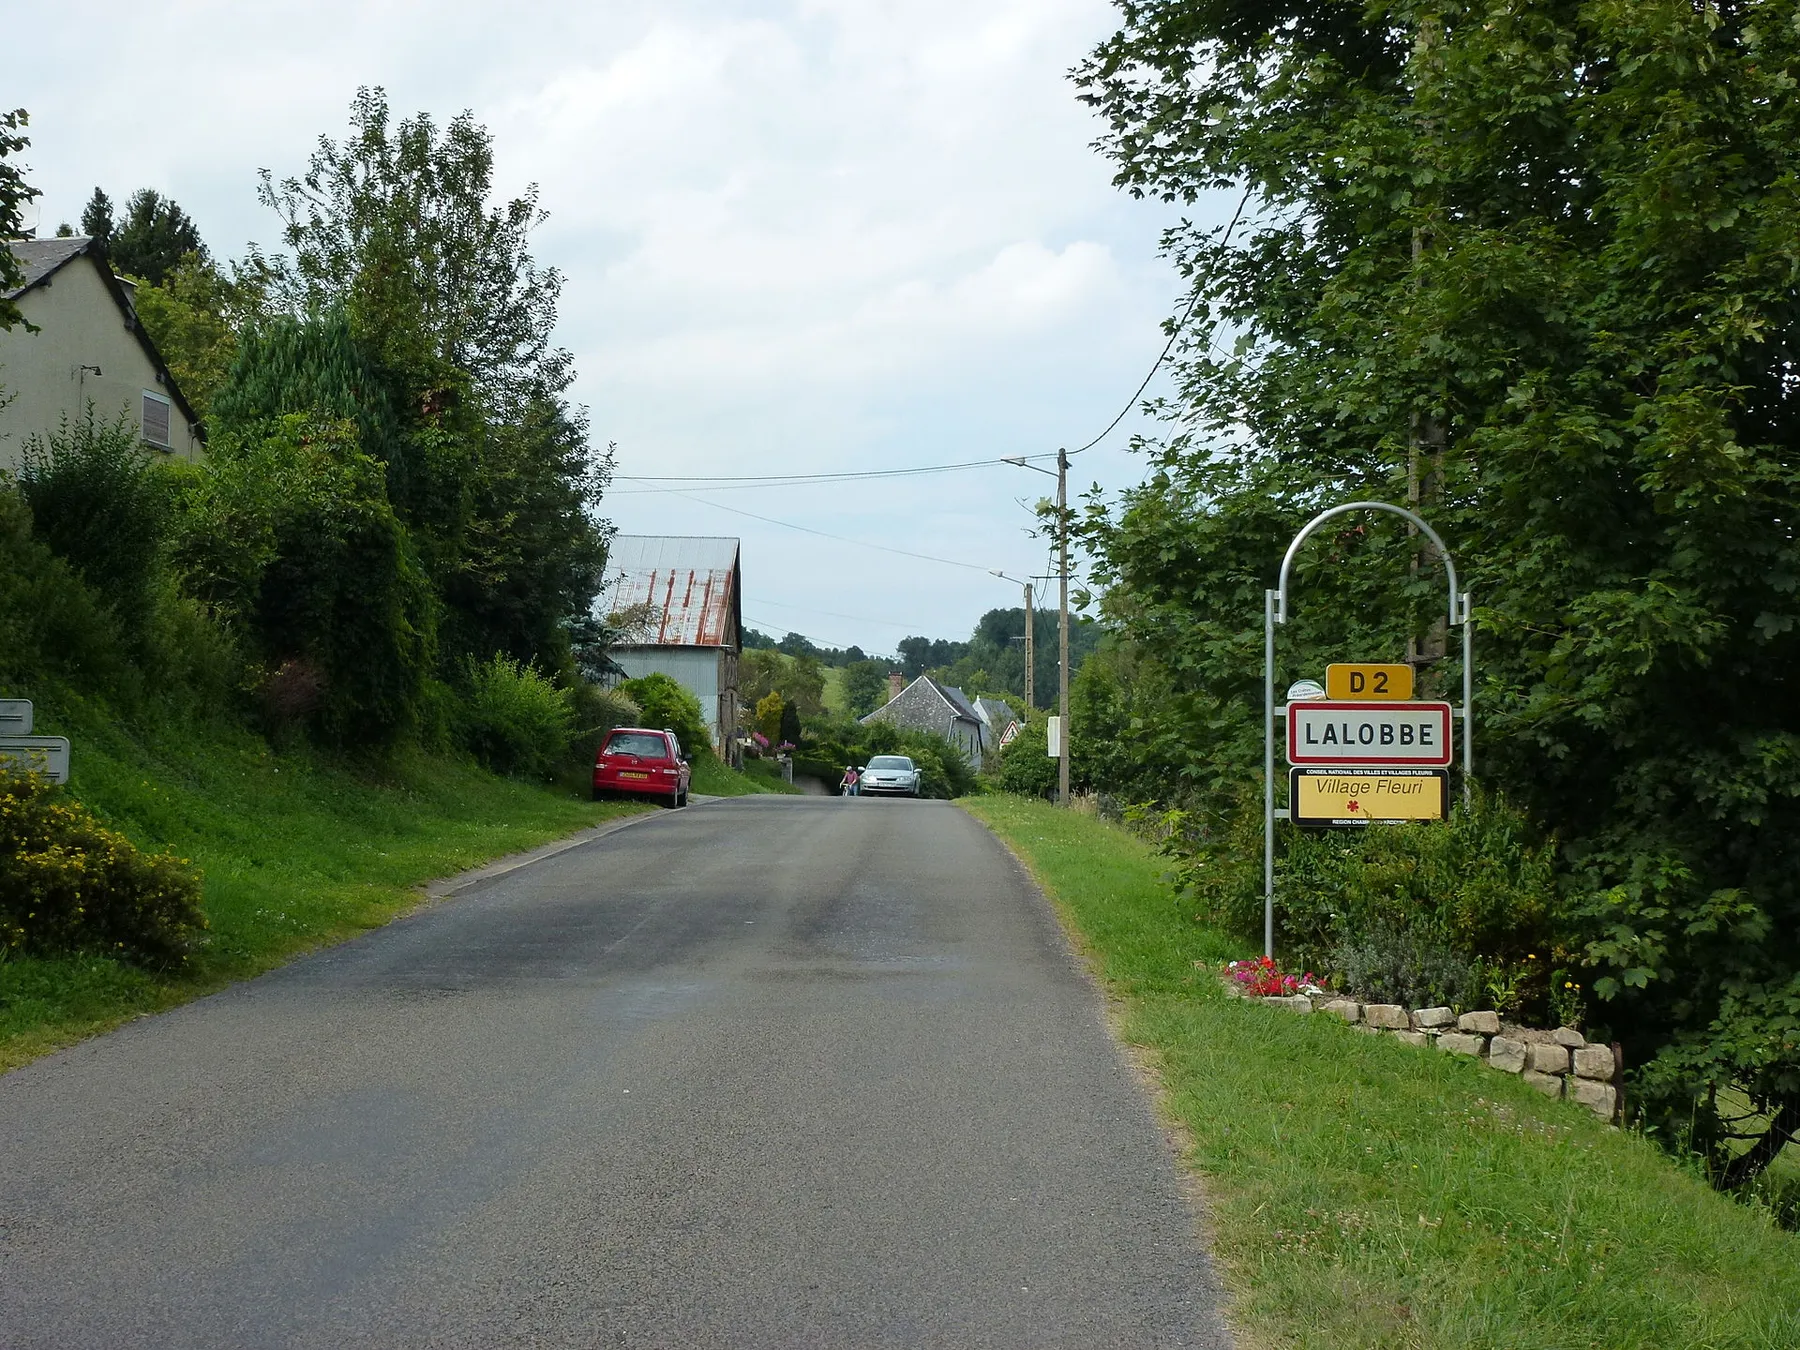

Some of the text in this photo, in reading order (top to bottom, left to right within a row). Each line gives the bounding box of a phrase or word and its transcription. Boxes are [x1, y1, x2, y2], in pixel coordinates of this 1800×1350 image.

[1350, 671, 1388, 693] D 2
[1306, 723, 1433, 745] LALOBBE
[1316, 779, 1423, 797] Village Fleuri
